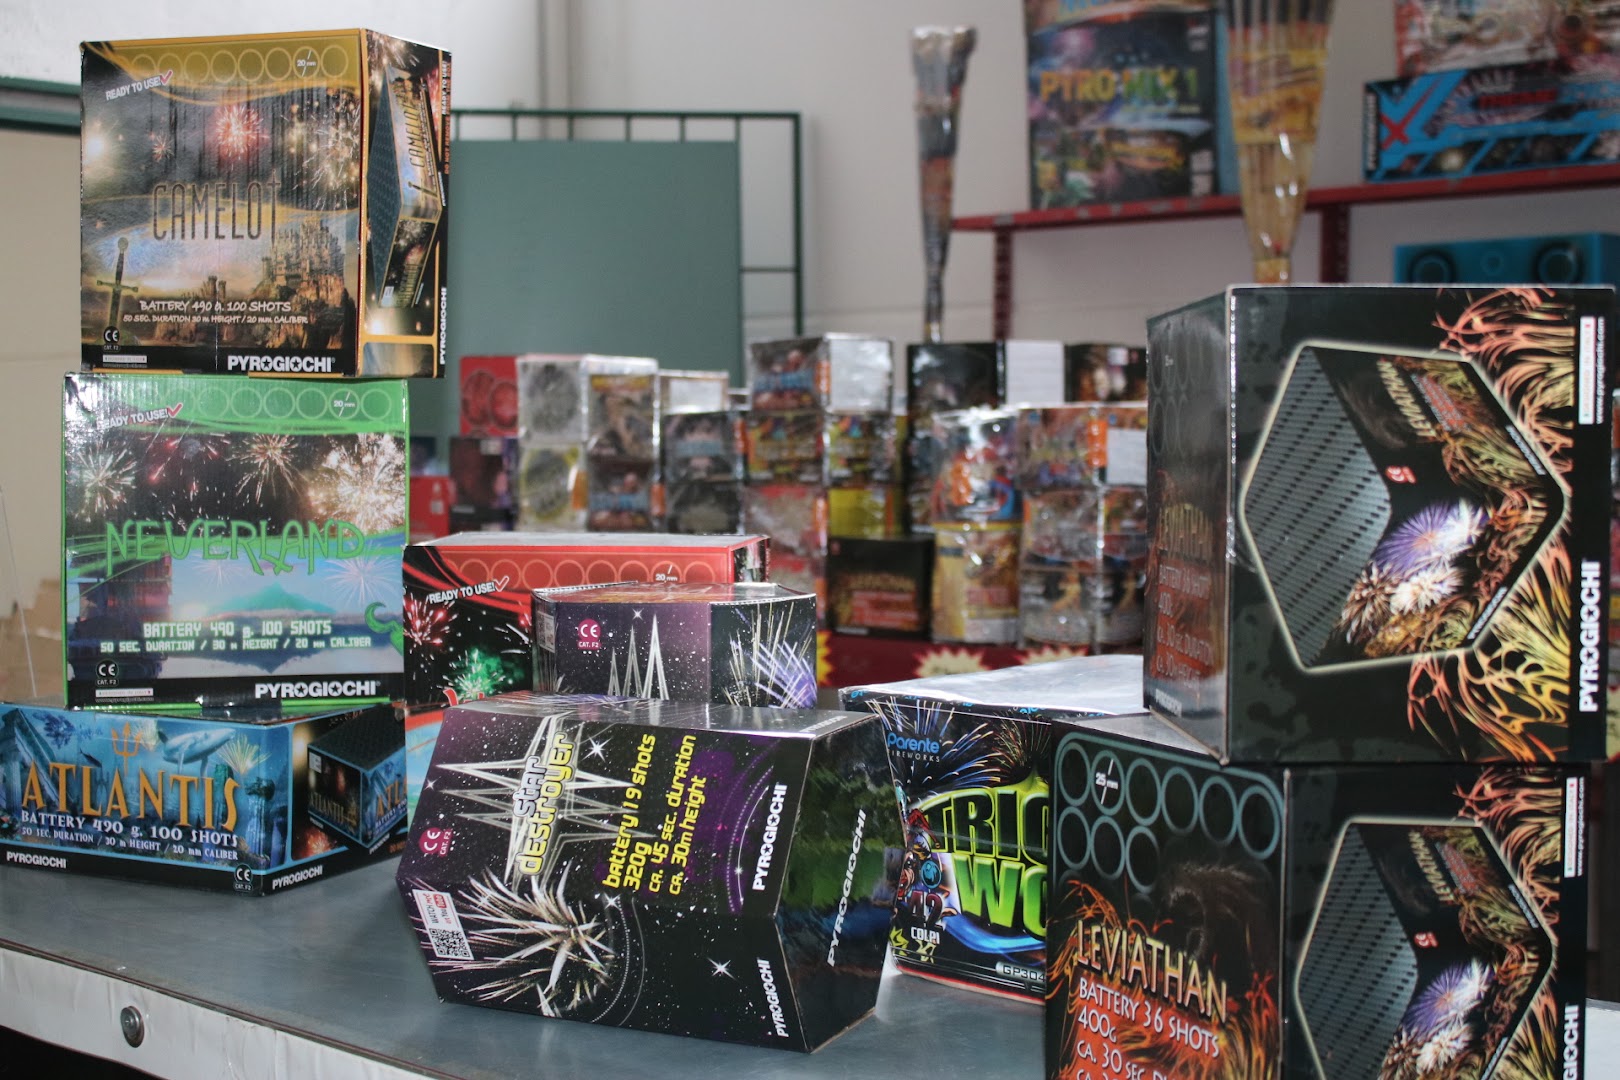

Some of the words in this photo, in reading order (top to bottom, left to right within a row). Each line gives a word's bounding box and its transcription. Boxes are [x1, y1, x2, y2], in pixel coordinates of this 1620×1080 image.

[297, 59, 306, 67] 20
[106, 86, 131, 101] READY
[131, 82, 143, 92] TO
[143, 76, 161, 90] USE!
[153, 171, 281, 249] CAMELOT
[139, 300, 190, 312] BATTERY
[191, 301, 212, 313] 490
[227, 301, 247, 312] 100
[248, 301, 292, 312] SHOTS
[152, 315, 191, 324] DURATION
[210, 314, 240, 323] HEIGHT
[246, 315, 256, 324] 20
[274, 315, 308, 324] CALIBER
[104, 330, 119, 342] CE
[228, 355, 332, 372] PYROGIOCHI
[334, 400, 344, 408] 20
[131, 414, 146, 424] TO
[147, 408, 169, 422] USE!
[105, 518, 366, 576] NEVERLAND
[655, 574, 666, 582] 20
[428, 588, 458, 604] READY
[460, 586, 474, 598] TO
[474, 582, 496, 595] USE!
[143, 622, 201, 638] BATTERY
[210, 622, 235, 636] 490
[262, 621, 283, 636] 100
[290, 620, 332, 635] SHOTS
[580, 624, 599, 638] CE
[1579, 561, 1602, 712] PYROGIOCHI
[100, 642, 114, 652] 50
[119, 642, 141, 652] SEC.
[146, 640, 195, 652] DURATION
[212, 640, 226, 650] 30
[242, 638, 279, 650] HEIGHT
[295, 638, 308, 649] 20
[330, 636, 372, 648] CALIBER
[98, 664, 116, 676] CE
[255, 680, 376, 698] PYROGIOCHI
[887, 732, 940, 754] Parente
[630, 734, 656, 786] shots
[889, 750, 940, 763] IREWORKS
[1096, 772, 1106, 786] 25
[21, 760, 240, 832] ATLANTIS
[650, 842, 670, 864] 45
[665, 734, 696, 808] duration
[678, 775, 707, 831] height
[22, 810, 86, 830] BATTERY
[92, 818, 124, 834] 490
[130, 826, 143, 838] g.
[151, 826, 182, 841] 100
[190, 829, 238, 848] SHOTS
[444, 830, 452, 840] F2
[752, 784, 788, 892] PYROGIOCHI
[54, 830, 94, 843] DURATION
[105, 837, 116, 846] 30
[129, 838, 161, 852] HEIGHT
[172, 844, 184, 854] 20
[204, 848, 238, 860] CALIBER
[424, 830, 441, 852] CE
[440, 840, 449, 855] CAT.
[670, 832, 694, 868] 30m
[6, 850, 68, 869] PYROGIOCHI
[622, 842, 652, 890] 320g
[236, 866, 251, 882] CE
[272, 865, 324, 890] PYROGIOCHI
[826, 808, 867, 967] PYROGIOCHI
[426, 904, 439, 924] WATCH
[908, 890, 945, 930] 42
[910, 926, 940, 944] COLPI
[1077, 920, 1227, 1024] LEVIATHAN
[757, 958, 790, 1038] PYROGIOCHI
[1079, 976, 1140, 1021] BATTERY
[1143, 1001, 1164, 1033] 36
[1168, 1016, 1220, 1058] SHOTS
[1563, 1004, 1579, 1080] GIOCHI
[1076, 1040, 1096, 1063] CA.
[1102, 1043, 1122, 1073] 30
